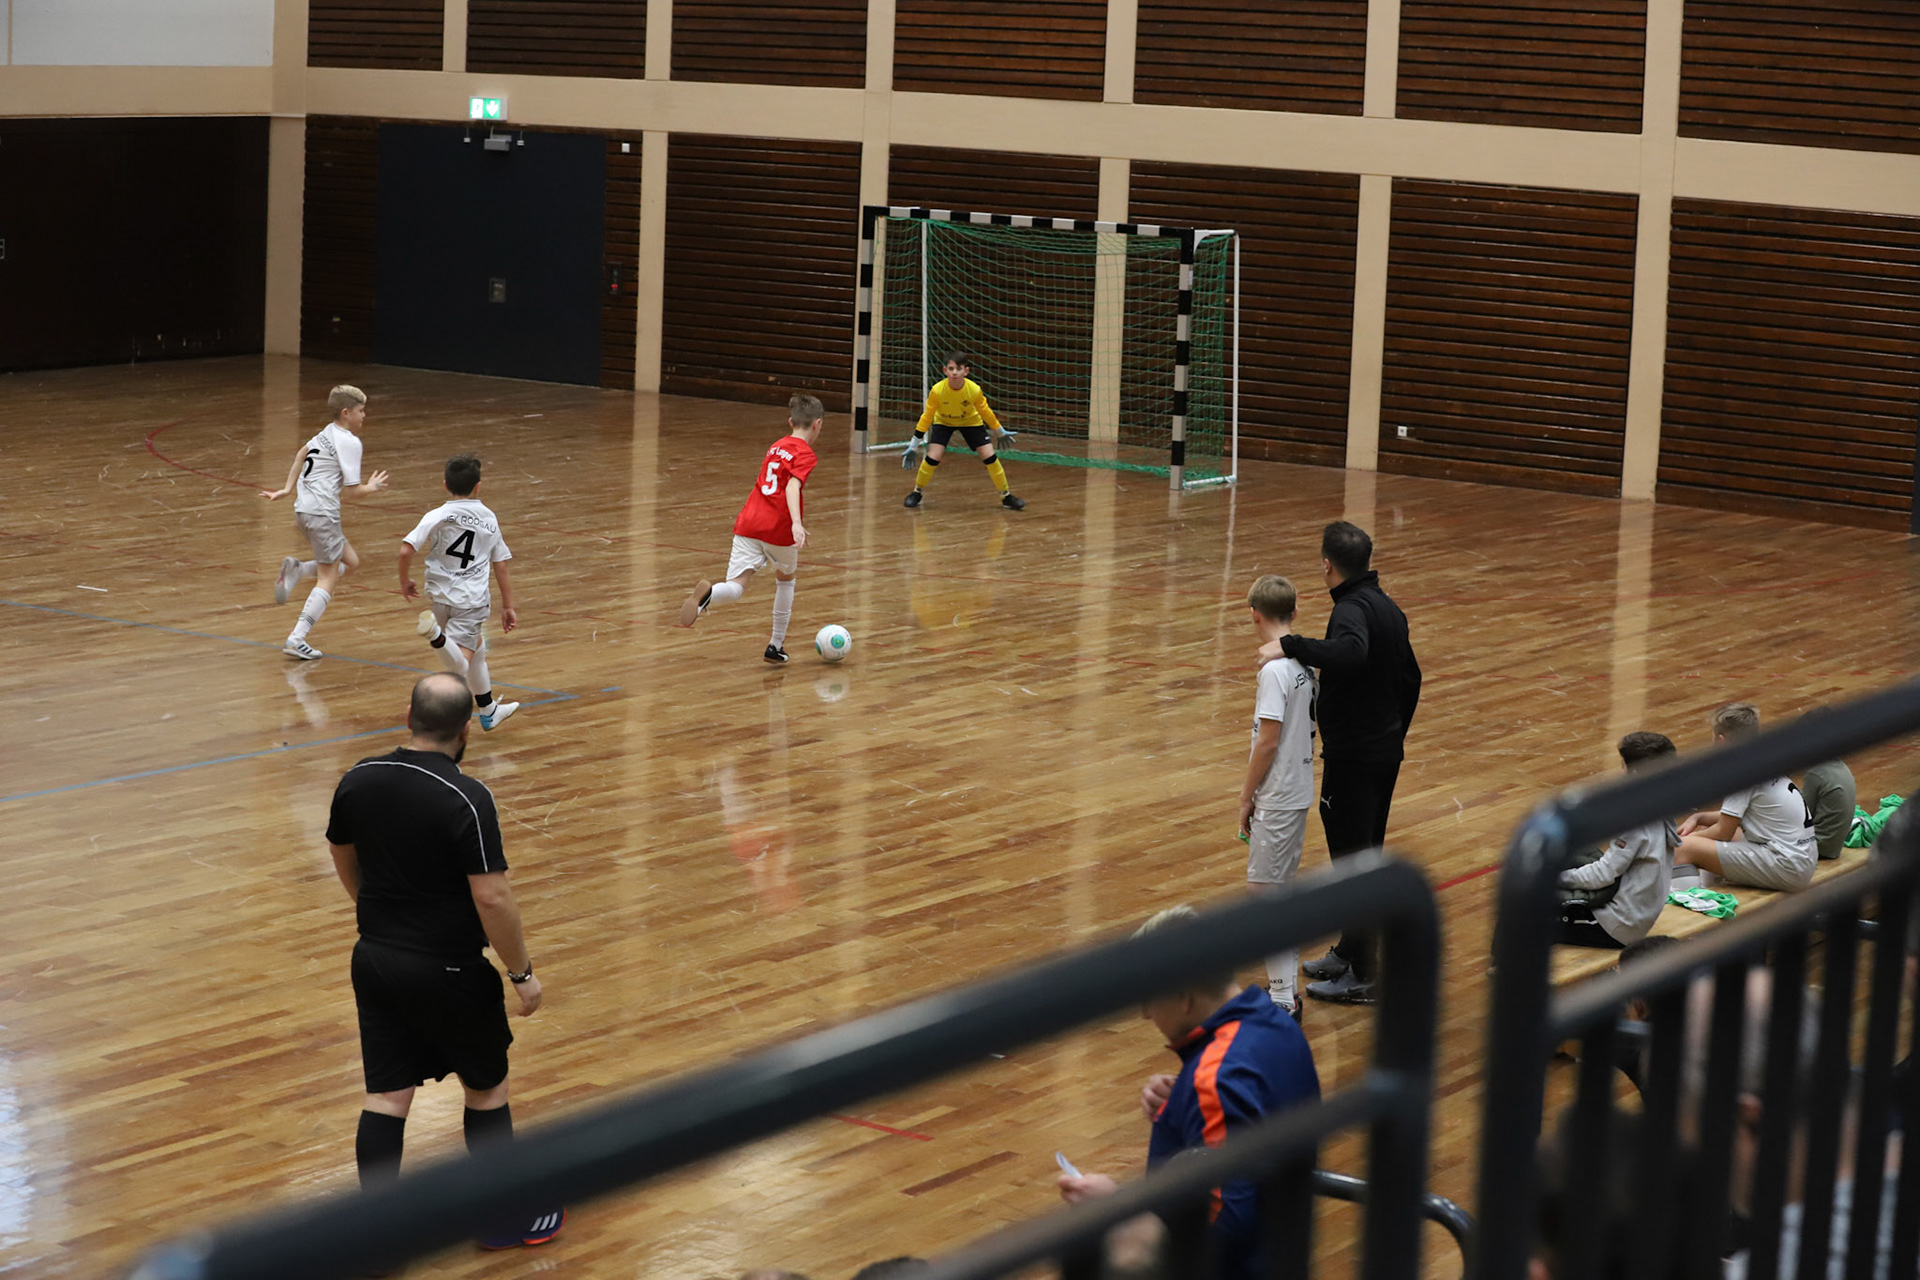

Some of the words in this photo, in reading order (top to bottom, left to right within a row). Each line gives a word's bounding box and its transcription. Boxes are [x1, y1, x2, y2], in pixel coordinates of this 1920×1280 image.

[761, 461, 780, 496] 5
[460, 515, 497, 534] RODGAU
[445, 529, 476, 570] 4
